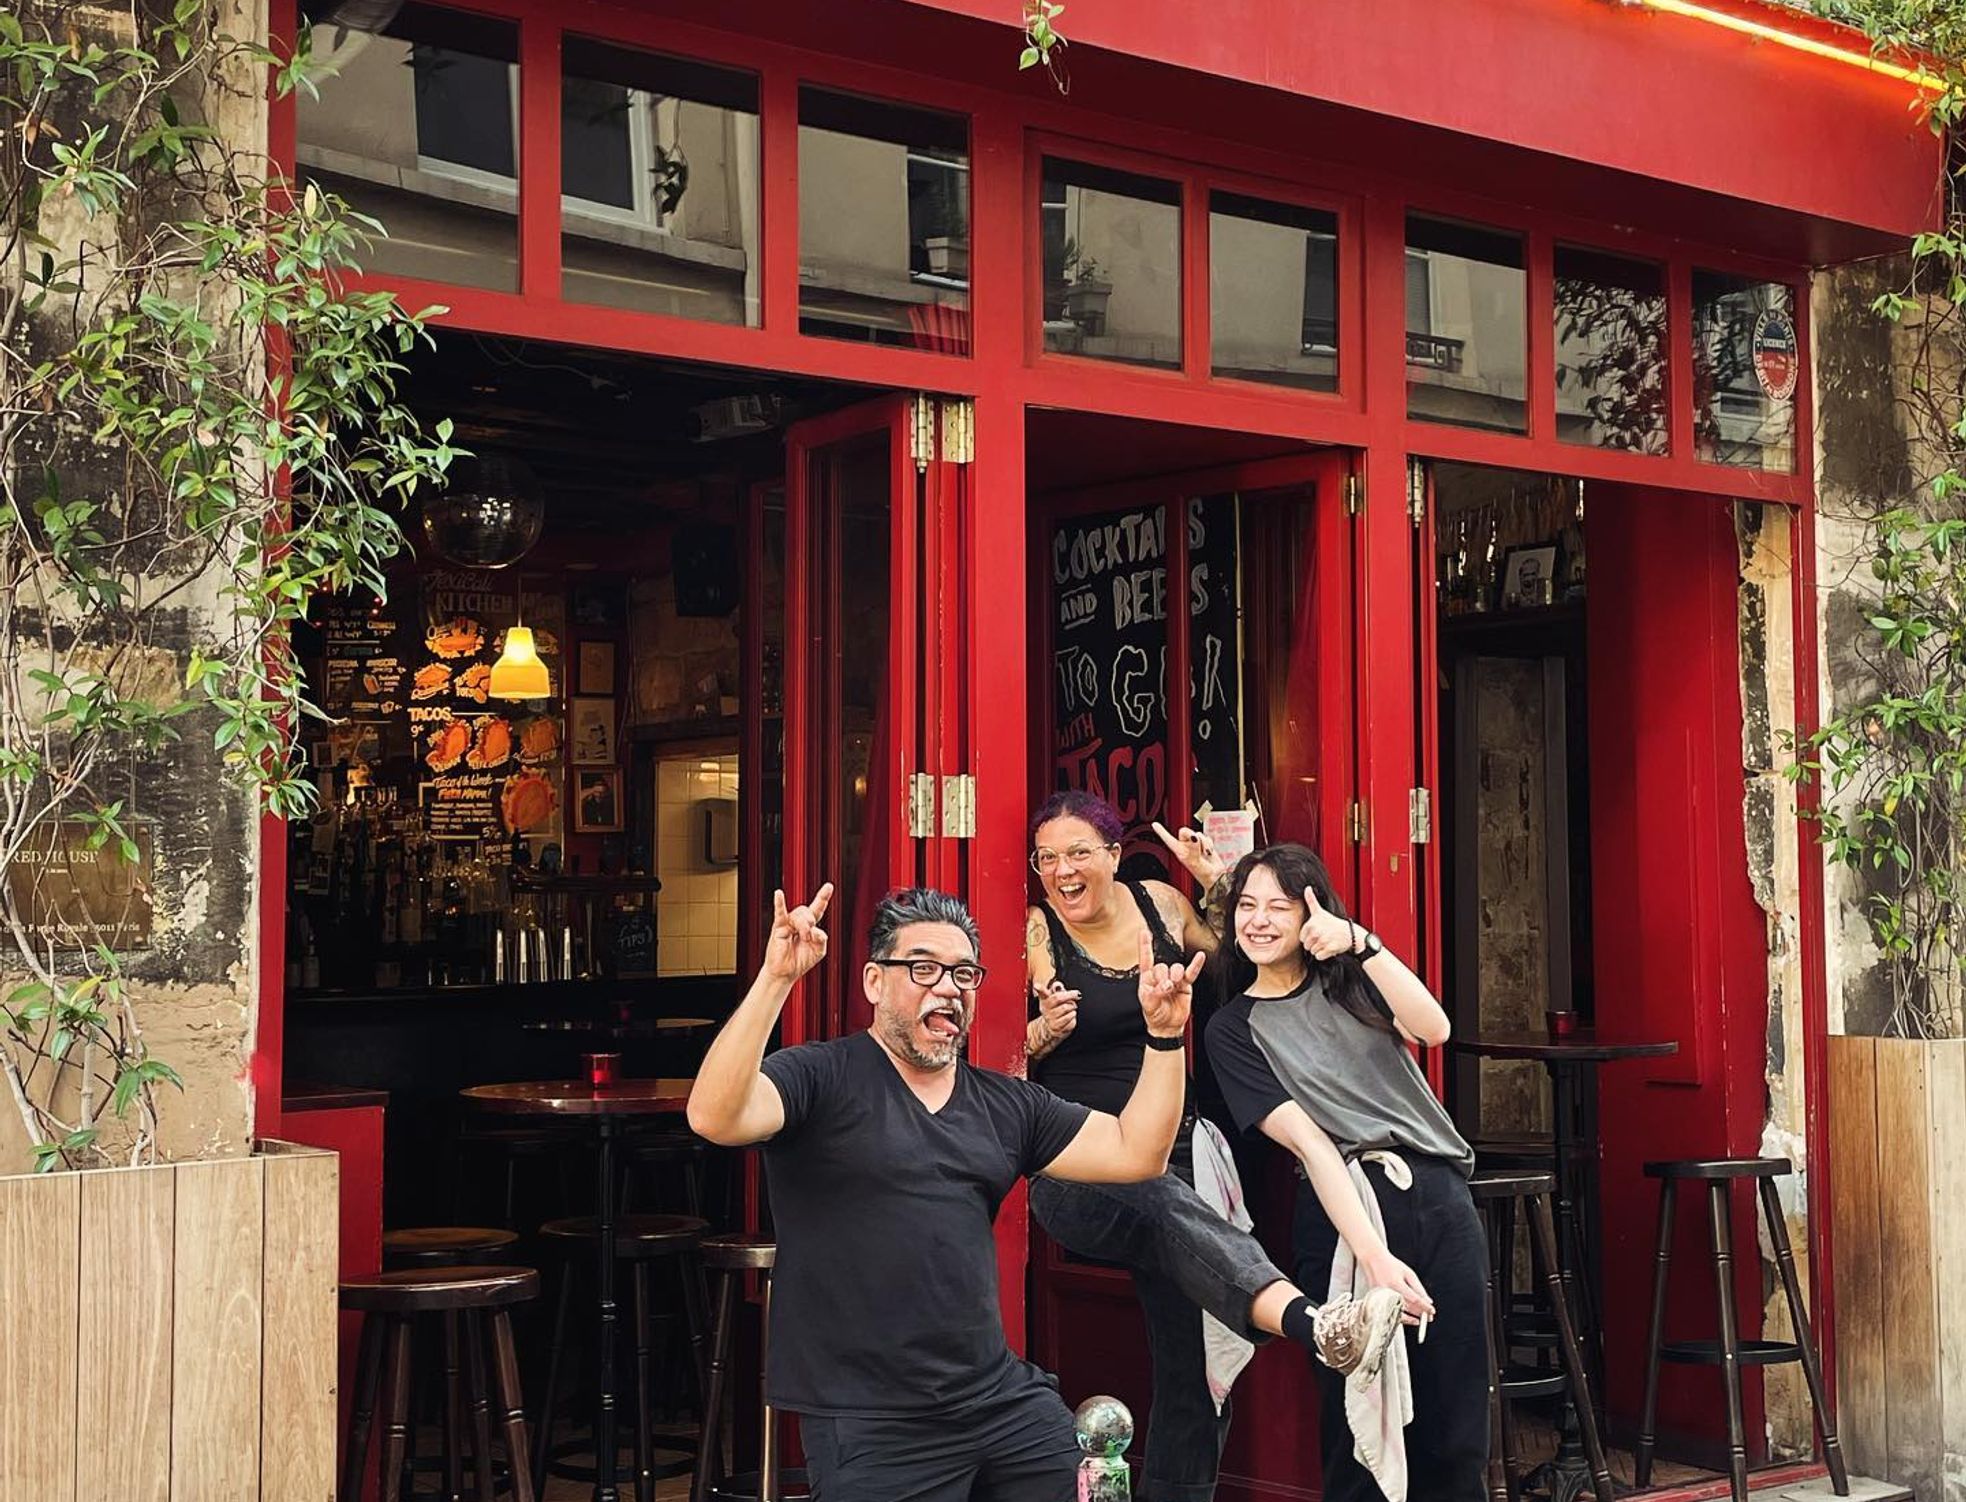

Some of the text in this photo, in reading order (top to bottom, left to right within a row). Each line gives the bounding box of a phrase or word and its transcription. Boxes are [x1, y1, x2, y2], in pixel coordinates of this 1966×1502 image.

[1054, 498, 1205, 584] COCKTAIS
[1061, 563, 1209, 631] AND BEES
[407, 707, 452, 722] TACOS
[1055, 634, 1222, 738] TO G!
[11, 851, 41, 863] RED
